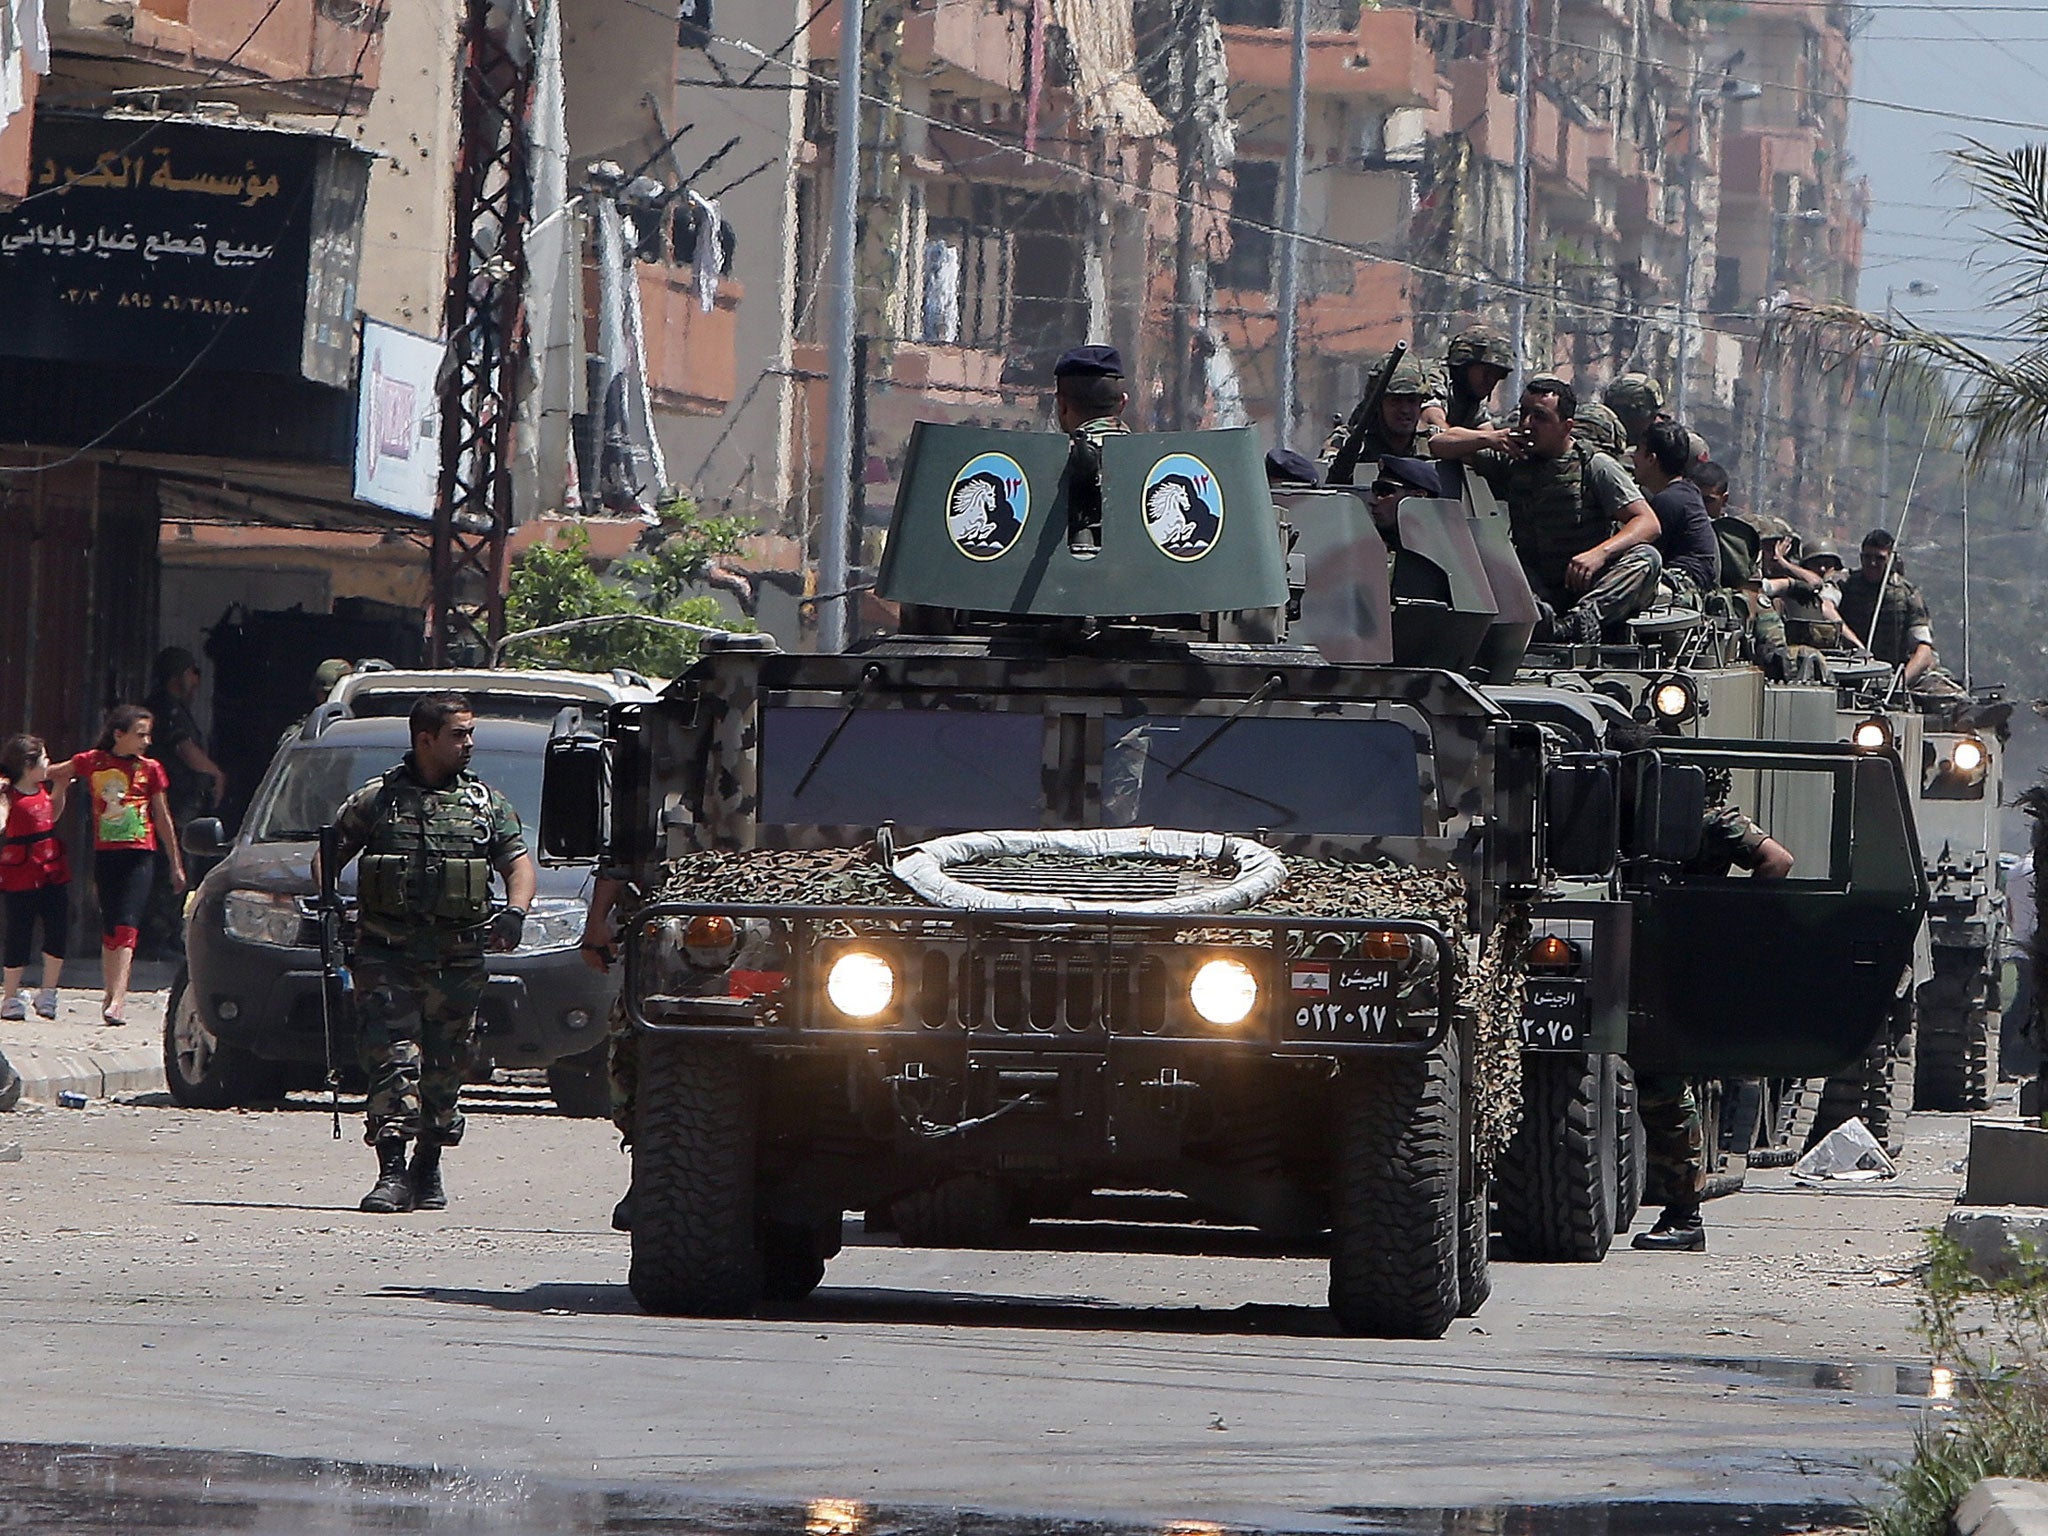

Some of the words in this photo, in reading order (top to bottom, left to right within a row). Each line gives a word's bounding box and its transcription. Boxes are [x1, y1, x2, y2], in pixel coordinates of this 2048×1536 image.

[38, 151, 144, 196] الكرد
[150, 147, 279, 207] مؤسسة
[1, 217, 76, 257] ياباني
[76, 223, 138, 259] غيار
[143, 222, 207, 261] قطع
[1339, 968, 1388, 990] الجيش
[1533, 988, 1575, 1008] الجيش
